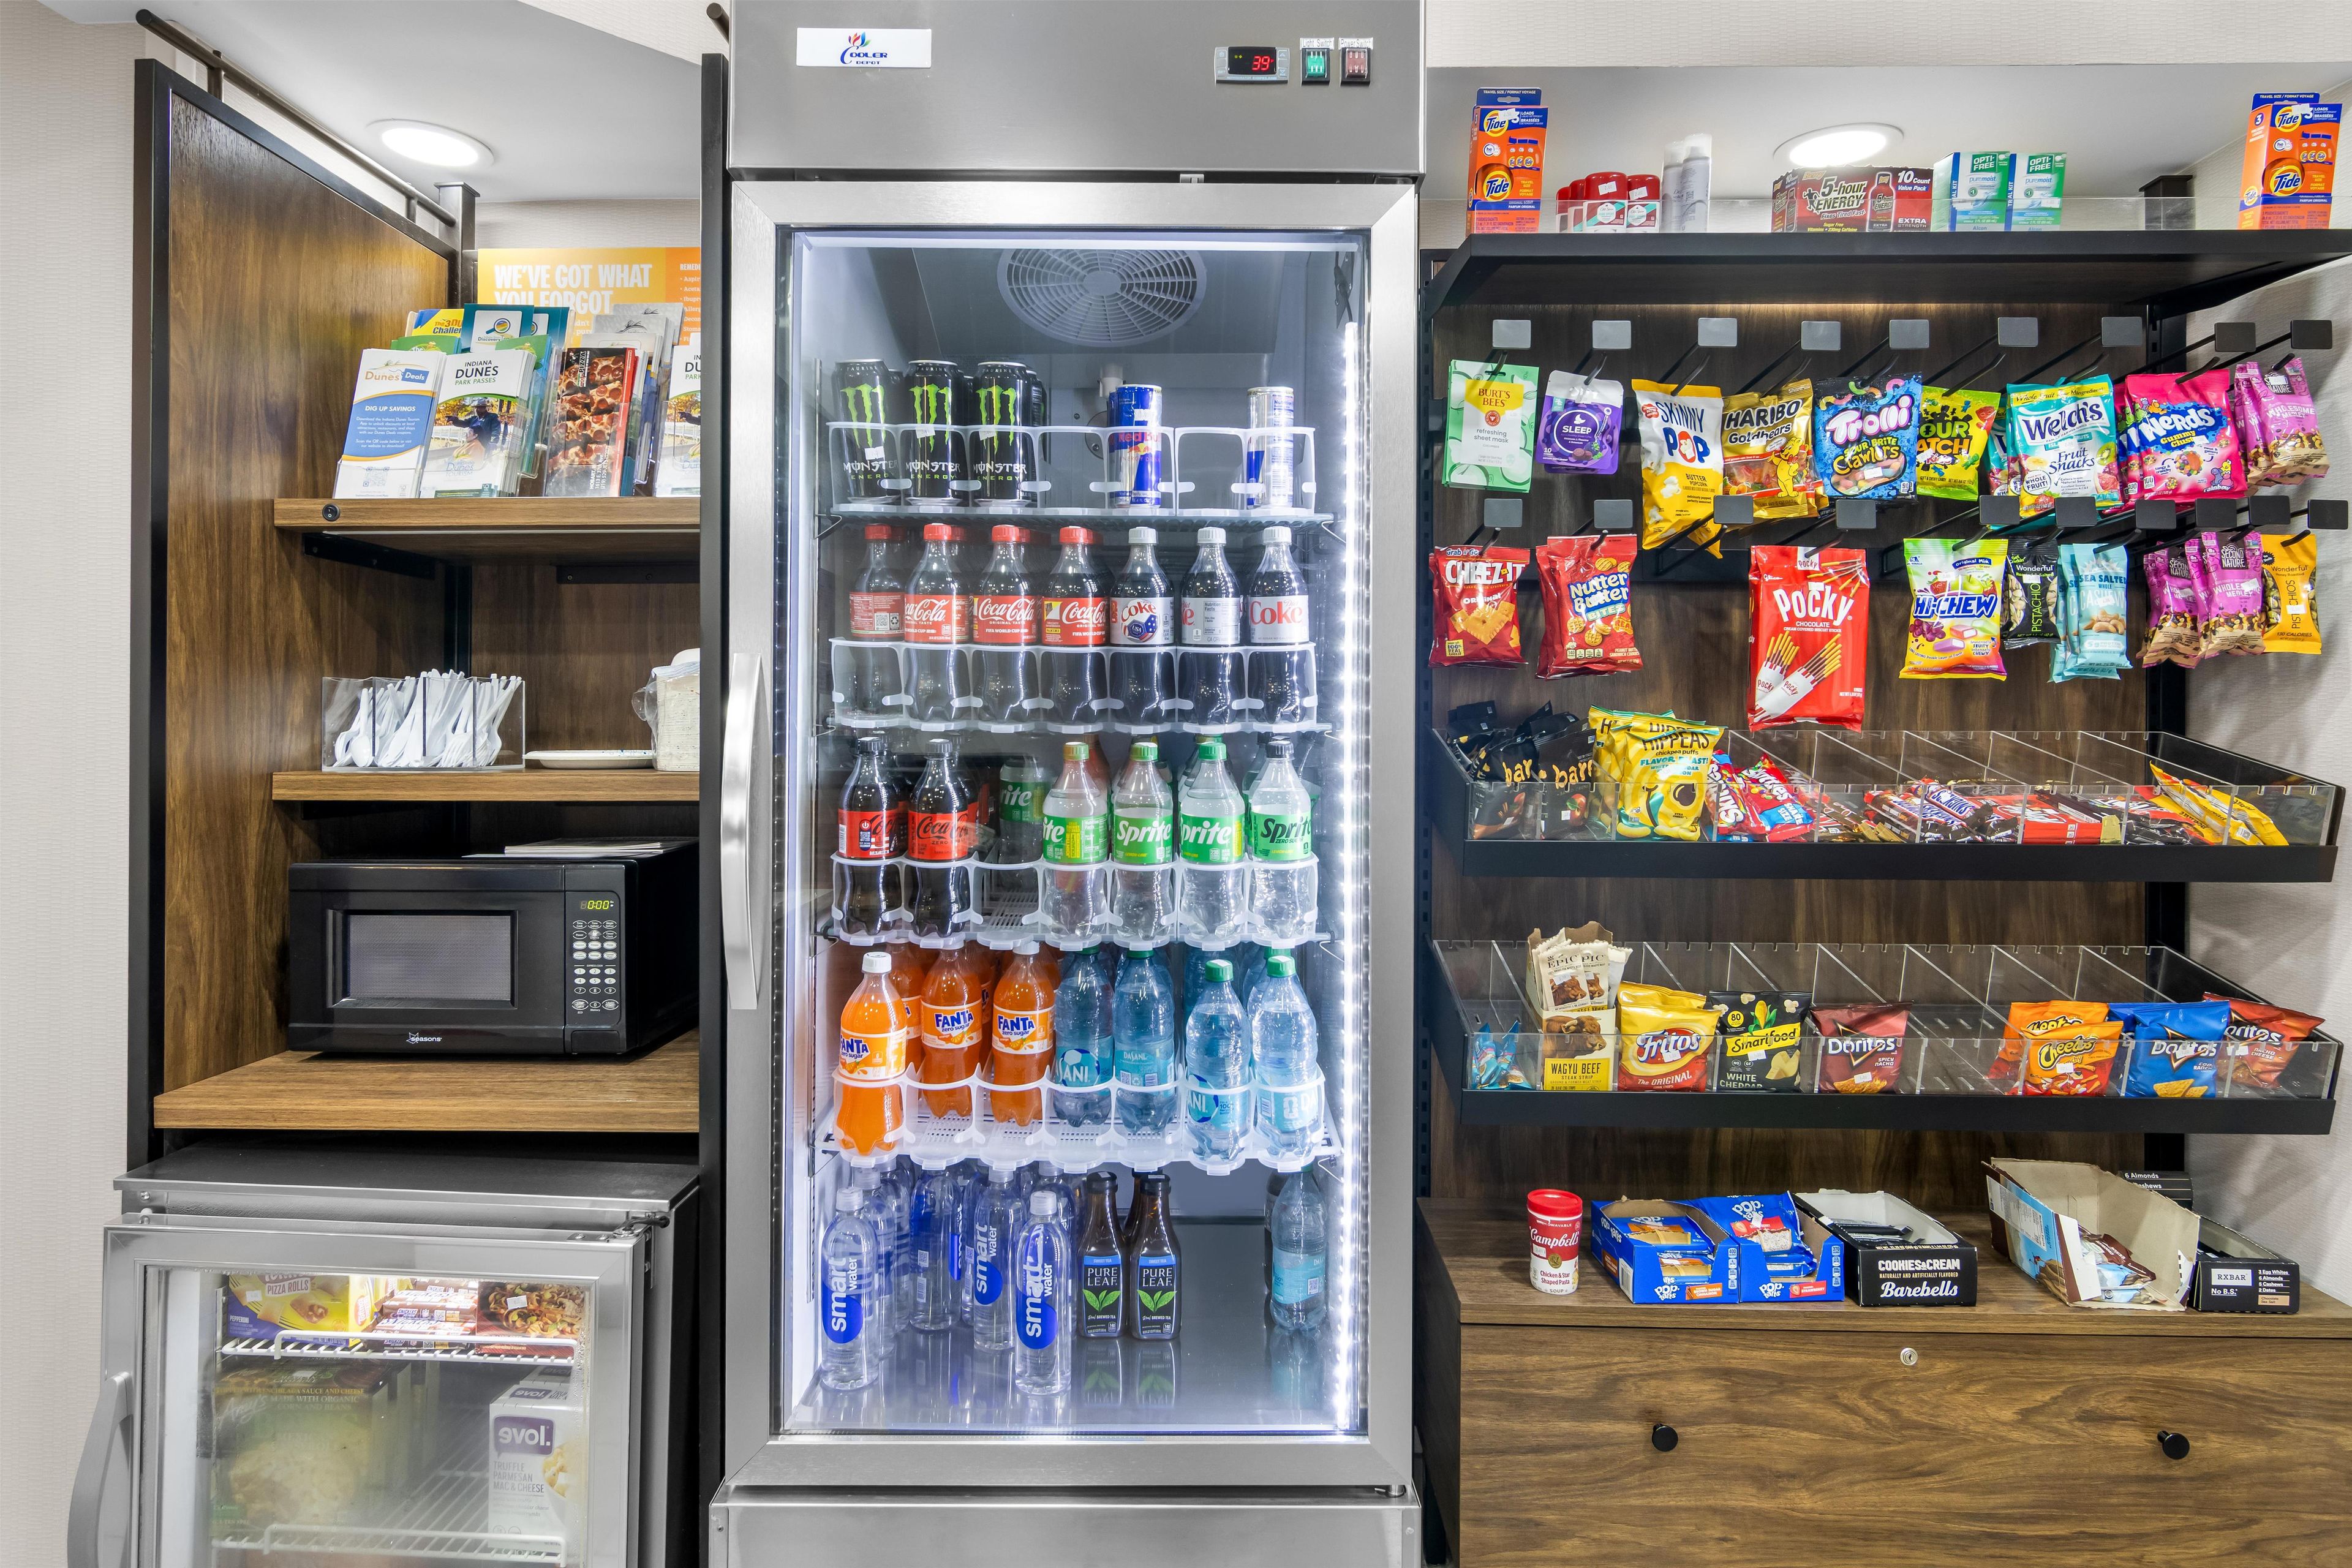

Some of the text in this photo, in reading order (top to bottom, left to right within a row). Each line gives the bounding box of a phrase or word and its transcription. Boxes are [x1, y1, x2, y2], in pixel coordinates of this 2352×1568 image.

[1252, 56, 1270, 70] 39
[1973, 155, 1996, 165] OPTI-
[1898, 171, 1912, 183] 10
[2274, 173, 2301, 193] Tide
[1486, 179, 1509, 198] Tide
[1822, 176, 1867, 197] 5-hour
[1815, 192, 1864, 212] ENERGY
[494, 265, 652, 288] WE'VE GOT WHAT
[365, 371, 399, 381] Dunes
[456, 366, 498, 379] DUNES
[1479, 388, 1510, 399] BURT'S
[1482, 398, 1505, 407] BEES
[1725, 399, 1803, 429] HARIBO
[1826, 394, 1914, 445] Trolli
[2022, 401, 2103, 440] Welch's
[1477, 428, 1507, 437] refreshing
[1562, 425, 1592, 434] SLEEP
[2058, 447, 2088, 462] Fruit
[906, 461, 960, 473] MONSTER
[2048, 457, 2095, 475] Snacks
[1686, 473, 1706, 482] BUTTER
[2025, 476, 2046, 485] WHOLE
[2027, 481, 2048, 491] FRUIT!
[2203, 483, 2231, 493] rainbow
[2221, 548, 2244, 559] SECOND
[2222, 557, 2246, 568] NATURE
[1570, 573, 1627, 599] Nutter
[978, 598, 1035, 621] Coca-Cola
[1250, 600, 1303, 626] Coke
[1587, 604, 1626, 621] BITES
[1913, 595, 1997, 617] HI-CHEW
[1642, 733, 1709, 751] HIPPEAS
[1116, 816, 1171, 846] Sprite
[587, 900, 609, 909] 0:00
[998, 1016, 1035, 1030] FANTA
[1637, 1032, 1702, 1060] Fritos
[1731, 1029, 1798, 1052] Smartfood
[1828, 1038, 1895, 1055] Doritos
[1123, 1052, 1147, 1061] DASANI
[2038, 1036, 2097, 1068] Cheetos
[1551, 1063, 1601, 1074] WAGYU BEEF
[1651, 1071, 1692, 1085] ORIGINAL
[1726, 1072, 1756, 1082] WHITE
[1530, 1225, 1579, 1250] Campbell's
[976, 1223, 988, 1294] smart
[1088, 1268, 1117, 1277] PURE
[267, 1280, 309, 1295] PIZZA ROLLS
[1087, 1276, 1117, 1286] LEAF
[831, 1257, 858, 1332] smart water
[1880, 1281, 1958, 1298] Barebells
[494, 1461, 525, 1472] TRUFFLE
[493, 1471, 532, 1482] PARMESAN
[493, 1482, 509, 1490] MAC
[518, 1483, 544, 1493] CHEESE
